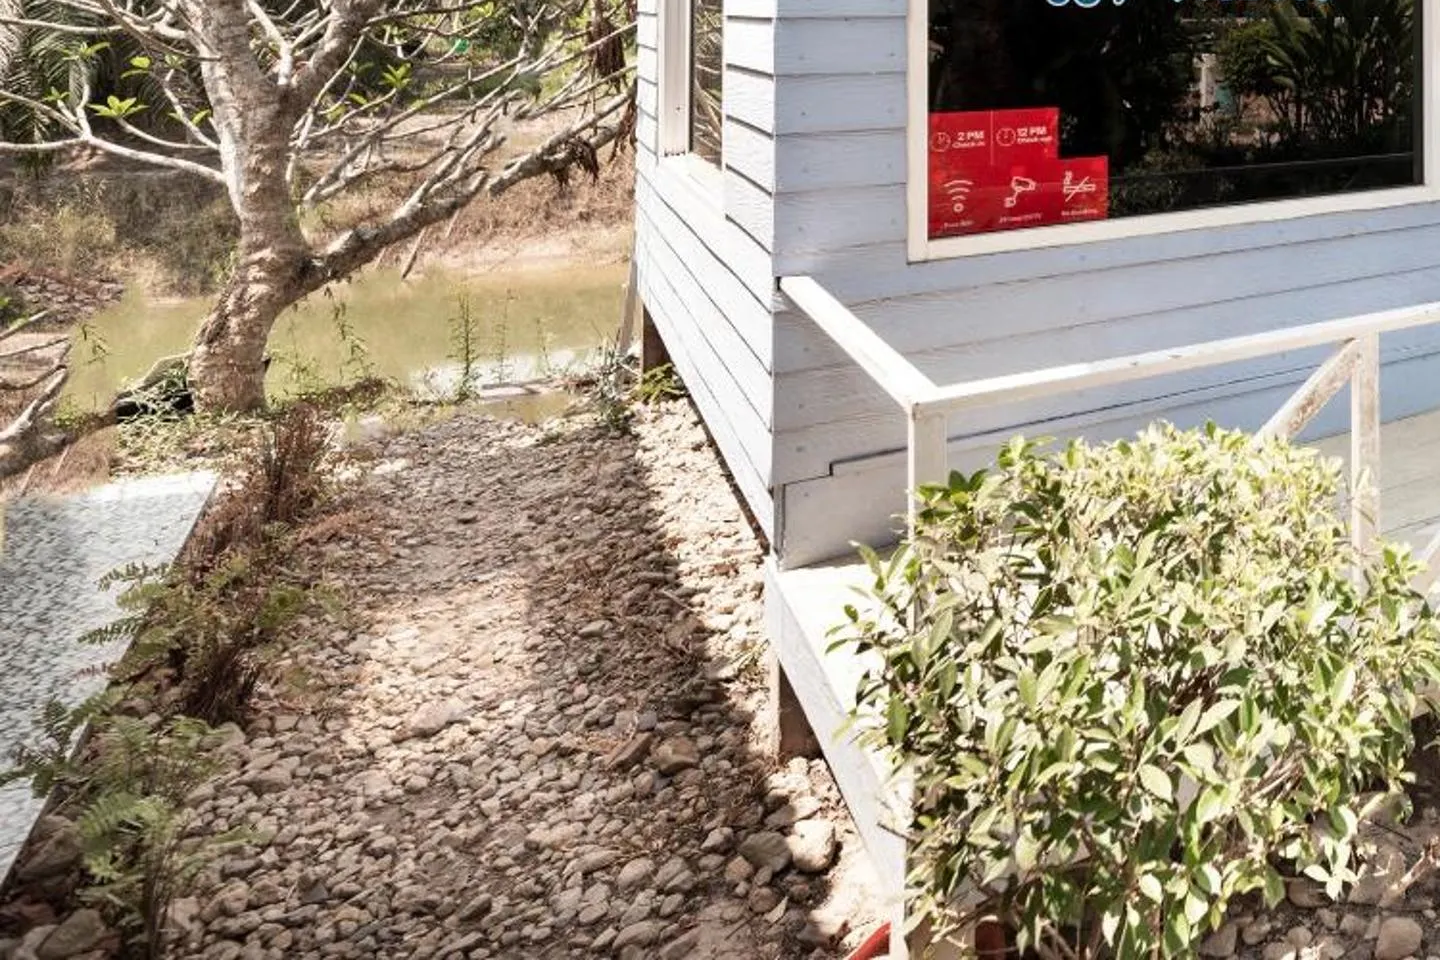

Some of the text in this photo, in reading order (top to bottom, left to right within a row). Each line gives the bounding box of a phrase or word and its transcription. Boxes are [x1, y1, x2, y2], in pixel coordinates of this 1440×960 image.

[957, 130, 985, 142] 2 PM
[1016, 125, 1047, 138] 12 PM
